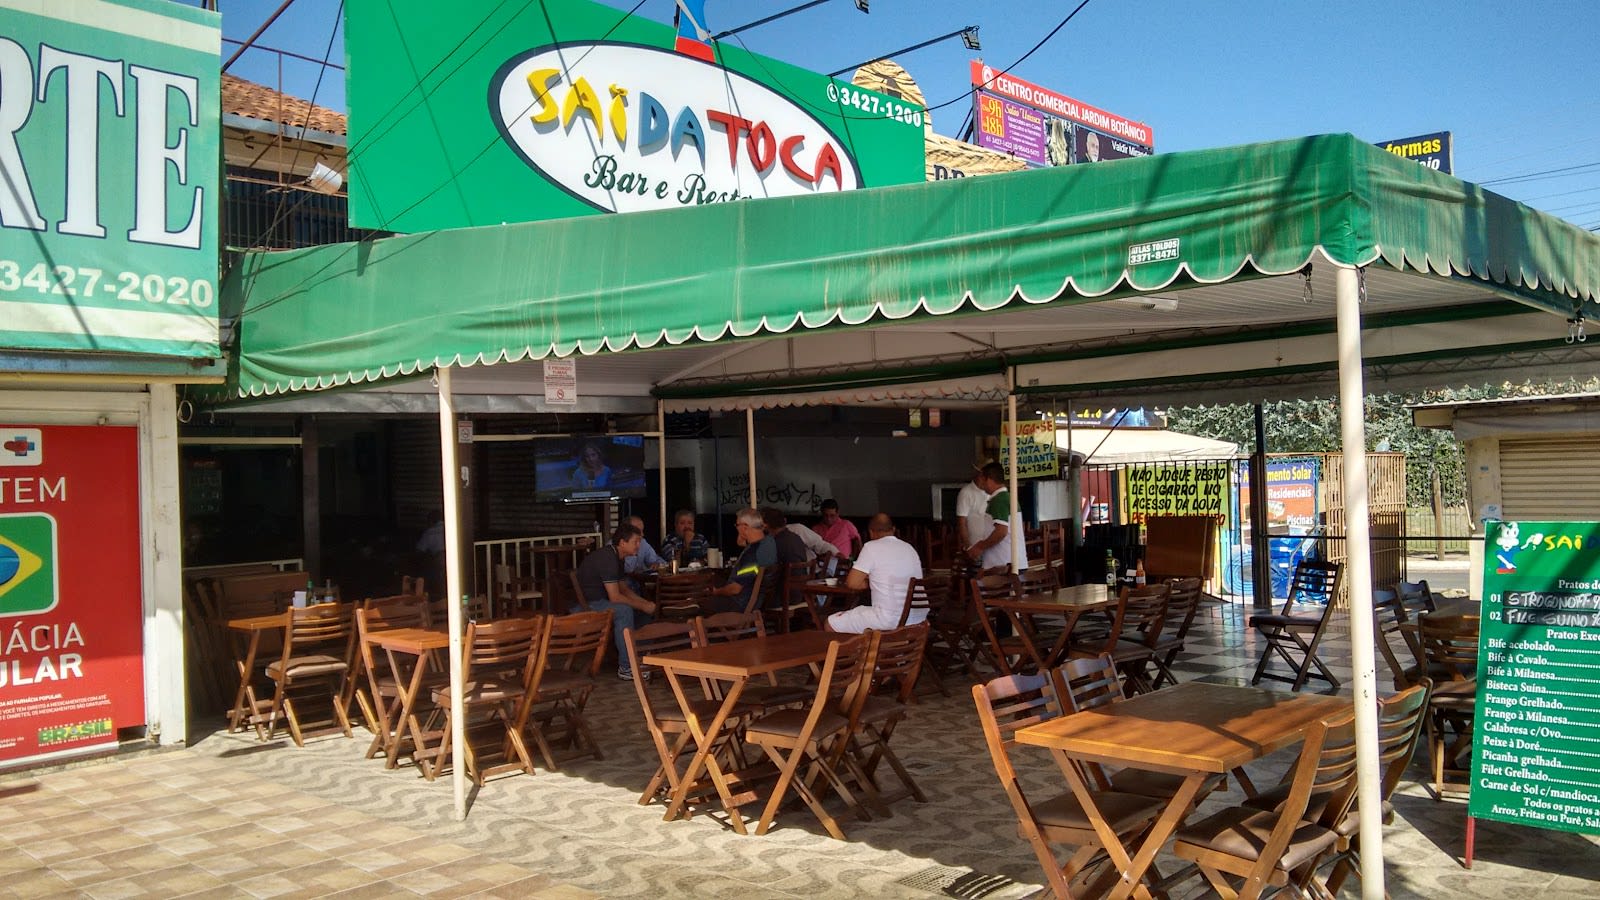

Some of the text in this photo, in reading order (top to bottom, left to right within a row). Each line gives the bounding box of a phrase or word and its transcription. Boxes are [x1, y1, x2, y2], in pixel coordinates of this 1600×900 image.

[841, 88, 921, 127] 3427-1200
[997, 77, 1032, 102] CENTRO
[1034, 90, 1080, 119] COMERCIAL
[1081, 108, 1110, 130] JARDIM
[1111, 121, 1146, 142] BOTÂNICO
[639, 92, 705, 168] DA
[707, 109, 843, 191] TOCA
[1111, 140, 1128, 154] Valdir
[583, 154, 649, 196] Bar
[654, 180, 669, 200] e
[1131, 240, 1178, 255] ATLAS TOLDOS
[0, 262, 214, 308] 3427-2020
[1292, 465, 1312, 480] Solar
[1131, 484, 1221, 496] DE CIGARRO NO
[1267, 486, 1312, 499] Residenciais
[1132, 498, 1222, 511] ACESSO DA LOJA
[1286, 513, 1314, 525] Piscinas
[1558, 580, 1590, 590] Pratos
[1490, 594, 1502, 603] 01
[1489, 612, 1502, 621] 02
[0, 621, 85, 656] ÁCIA
[1547, 629, 1578, 641] Pratos
[1488, 638, 1556, 652] Bife acebolado
[1487, 652, 1548, 666] Bife à Cavalo
[1487, 665, 1556, 680] Bife à Milanesa
[1486, 680, 1547, 694] Bisteca Suína
[1485, 693, 1563, 710] Frango Grelhado
[1484, 707, 1568, 725] Frango à Milanesa
[38, 719, 112, 743] BRASIL
[1483, 722, 1562, 740] Calabresa c/Ovo
[1483, 736, 1540, 751] Peixe à Doré
[1482, 750, 1562, 768] Picanha grelhada
[1481, 764, 1549, 781] Filet Grelhado
[1480, 778, 1509, 791] Carne
[1510, 781, 1521, 792] de
[1523, 783, 1539, 795] Sol
[1523, 797, 1551, 810] Todos
[1565, 805, 1593, 815] pratos
[1491, 805, 1518, 817] Arroz,
[1520, 808, 1545, 820] Fritas
[1546, 814, 1558, 822] ou
[1559, 813, 1584, 827] Purê,
